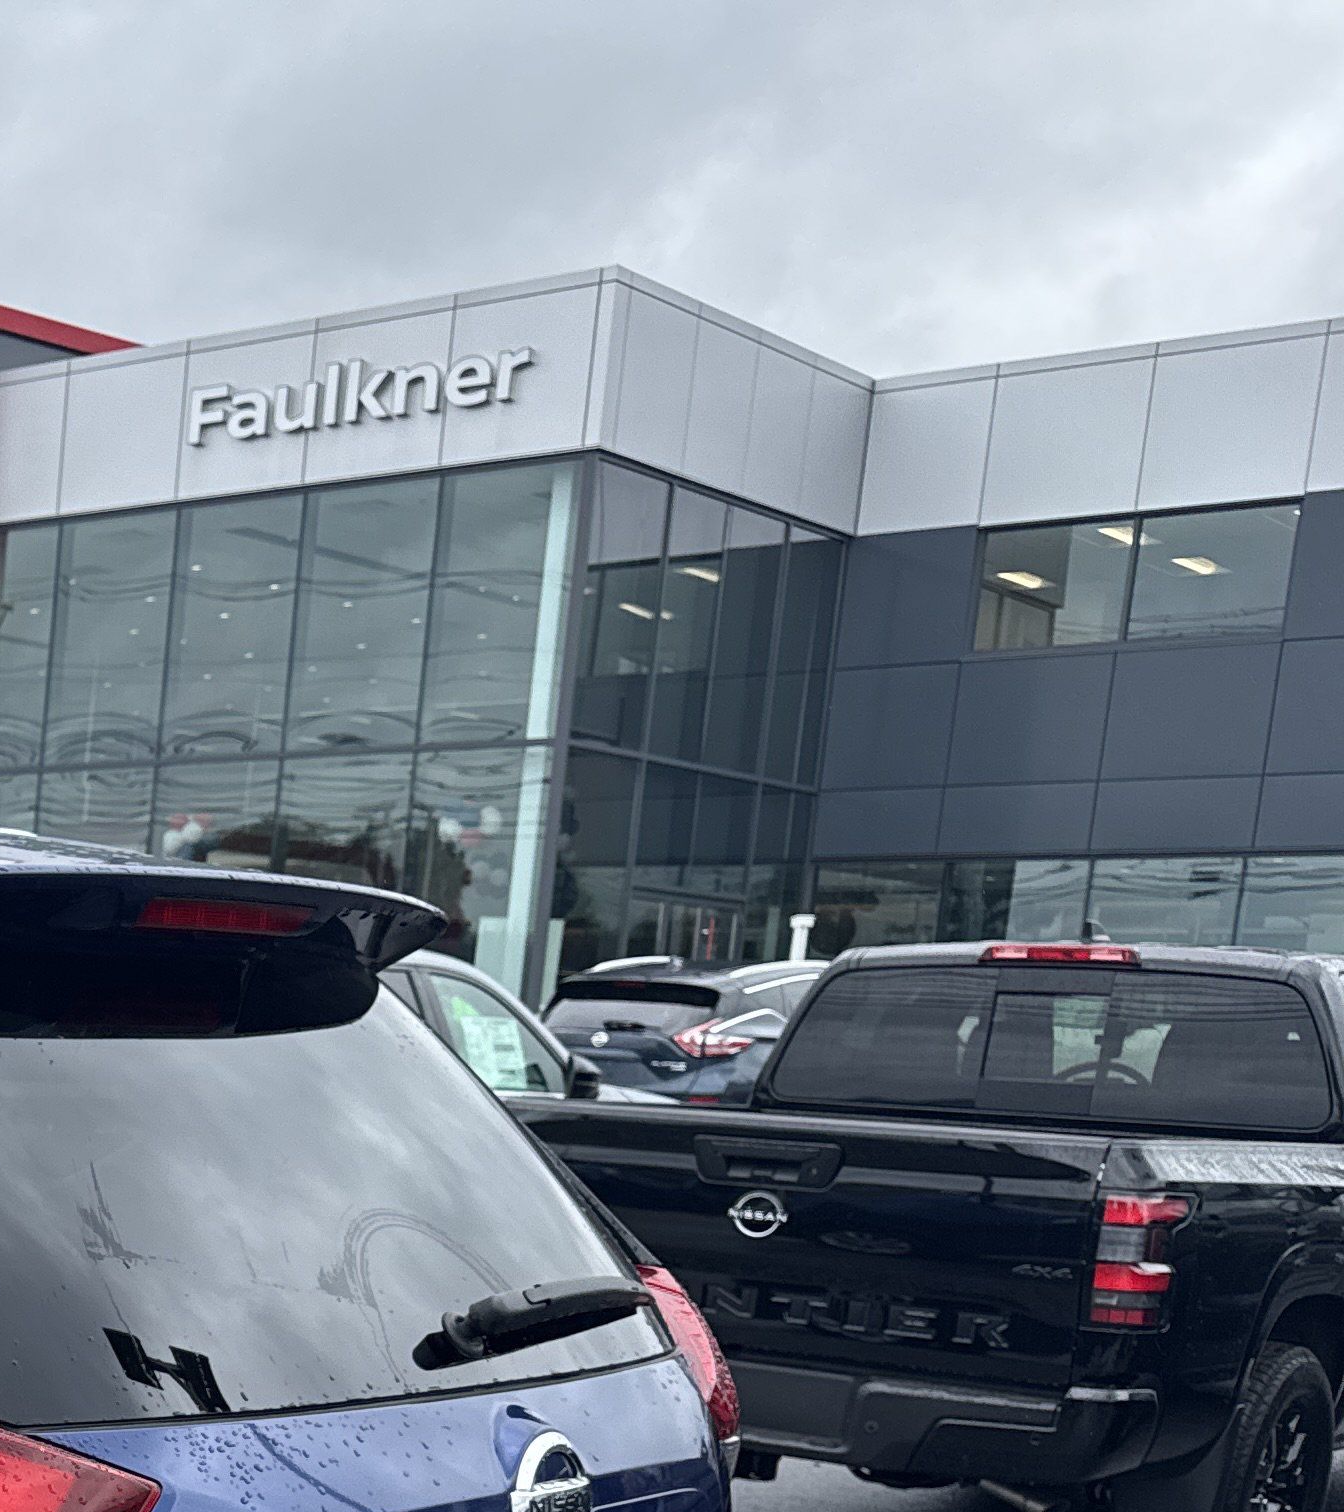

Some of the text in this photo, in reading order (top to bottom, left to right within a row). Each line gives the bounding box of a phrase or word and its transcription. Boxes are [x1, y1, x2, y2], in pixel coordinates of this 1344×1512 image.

[187, 346, 534, 446] Faulkner
[727, 1207, 788, 1223] NISSAN
[701, 1283, 1010, 1347] NTIER
